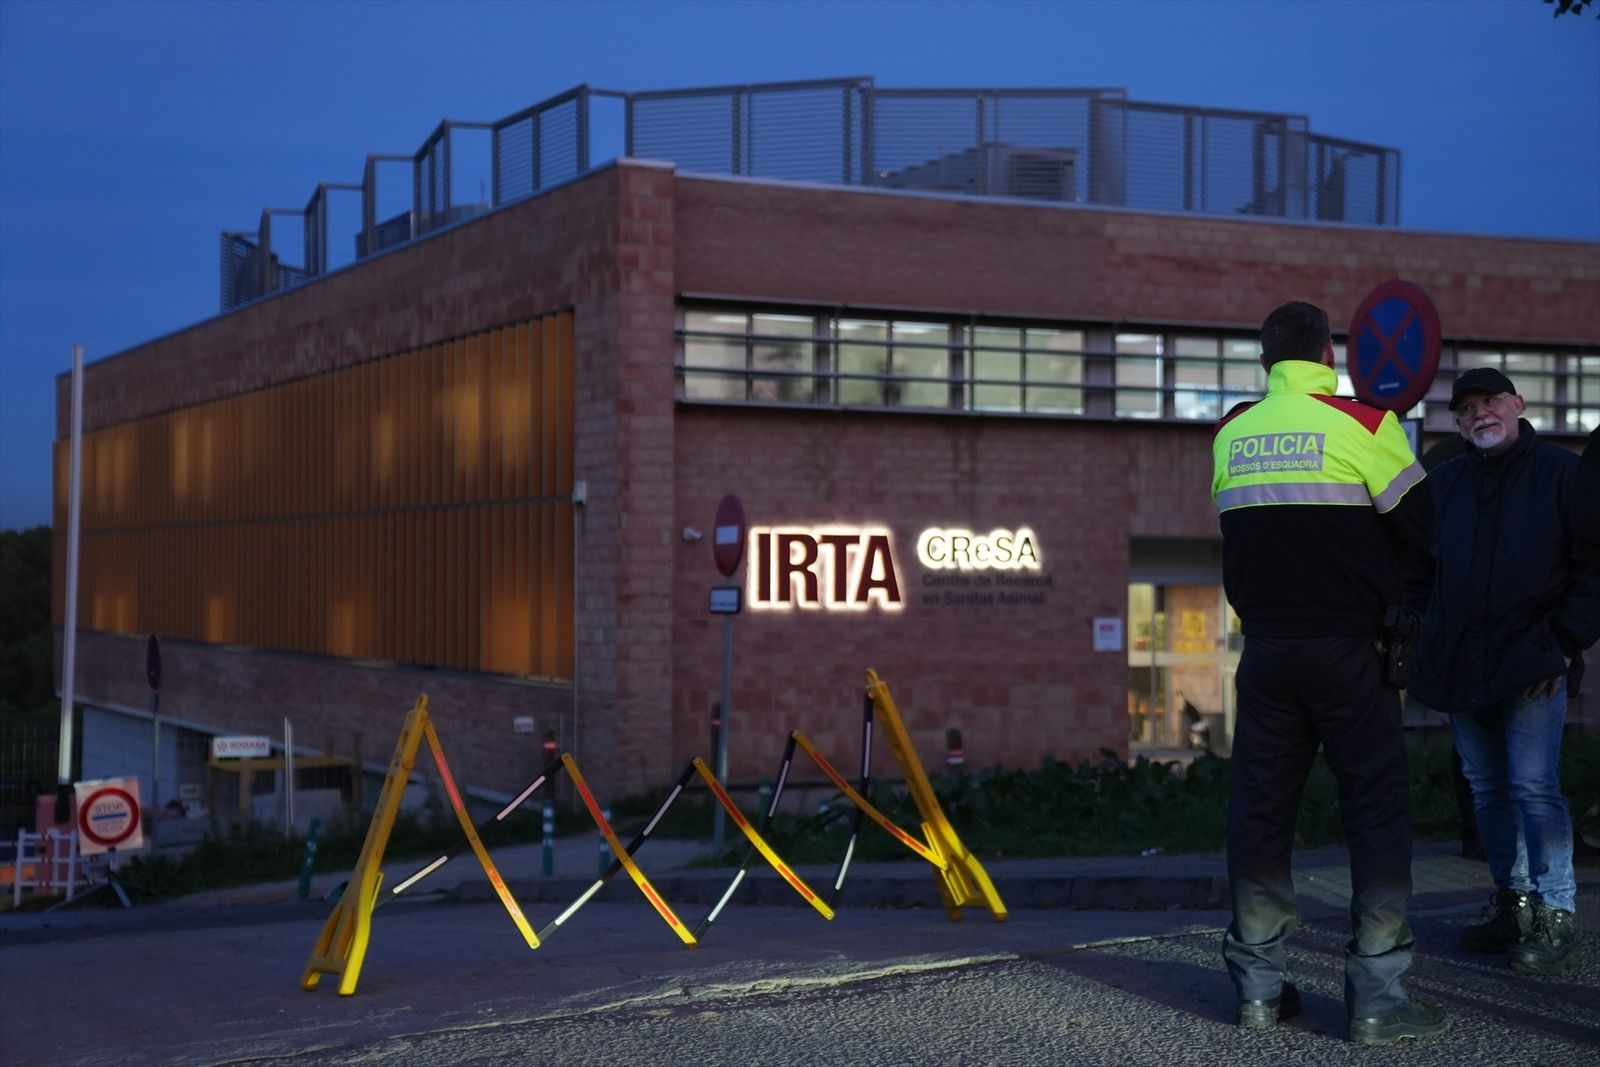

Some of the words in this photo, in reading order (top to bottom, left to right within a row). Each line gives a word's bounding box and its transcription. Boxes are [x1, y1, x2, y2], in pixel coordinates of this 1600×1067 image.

[1230, 435, 1319, 460] POLICIA
[1230, 462, 1261, 473] MOSSOS
[1263, 460, 1319, 470] D'ESQUADRA
[925, 534, 1038, 564] CReSA
[756, 531, 902, 603] IRTA
[974, 574, 991, 587] de
[921, 593, 940, 605] en
[944, 591, 993, 606] Sanitat
[996, 592, 1046, 605] Animal
